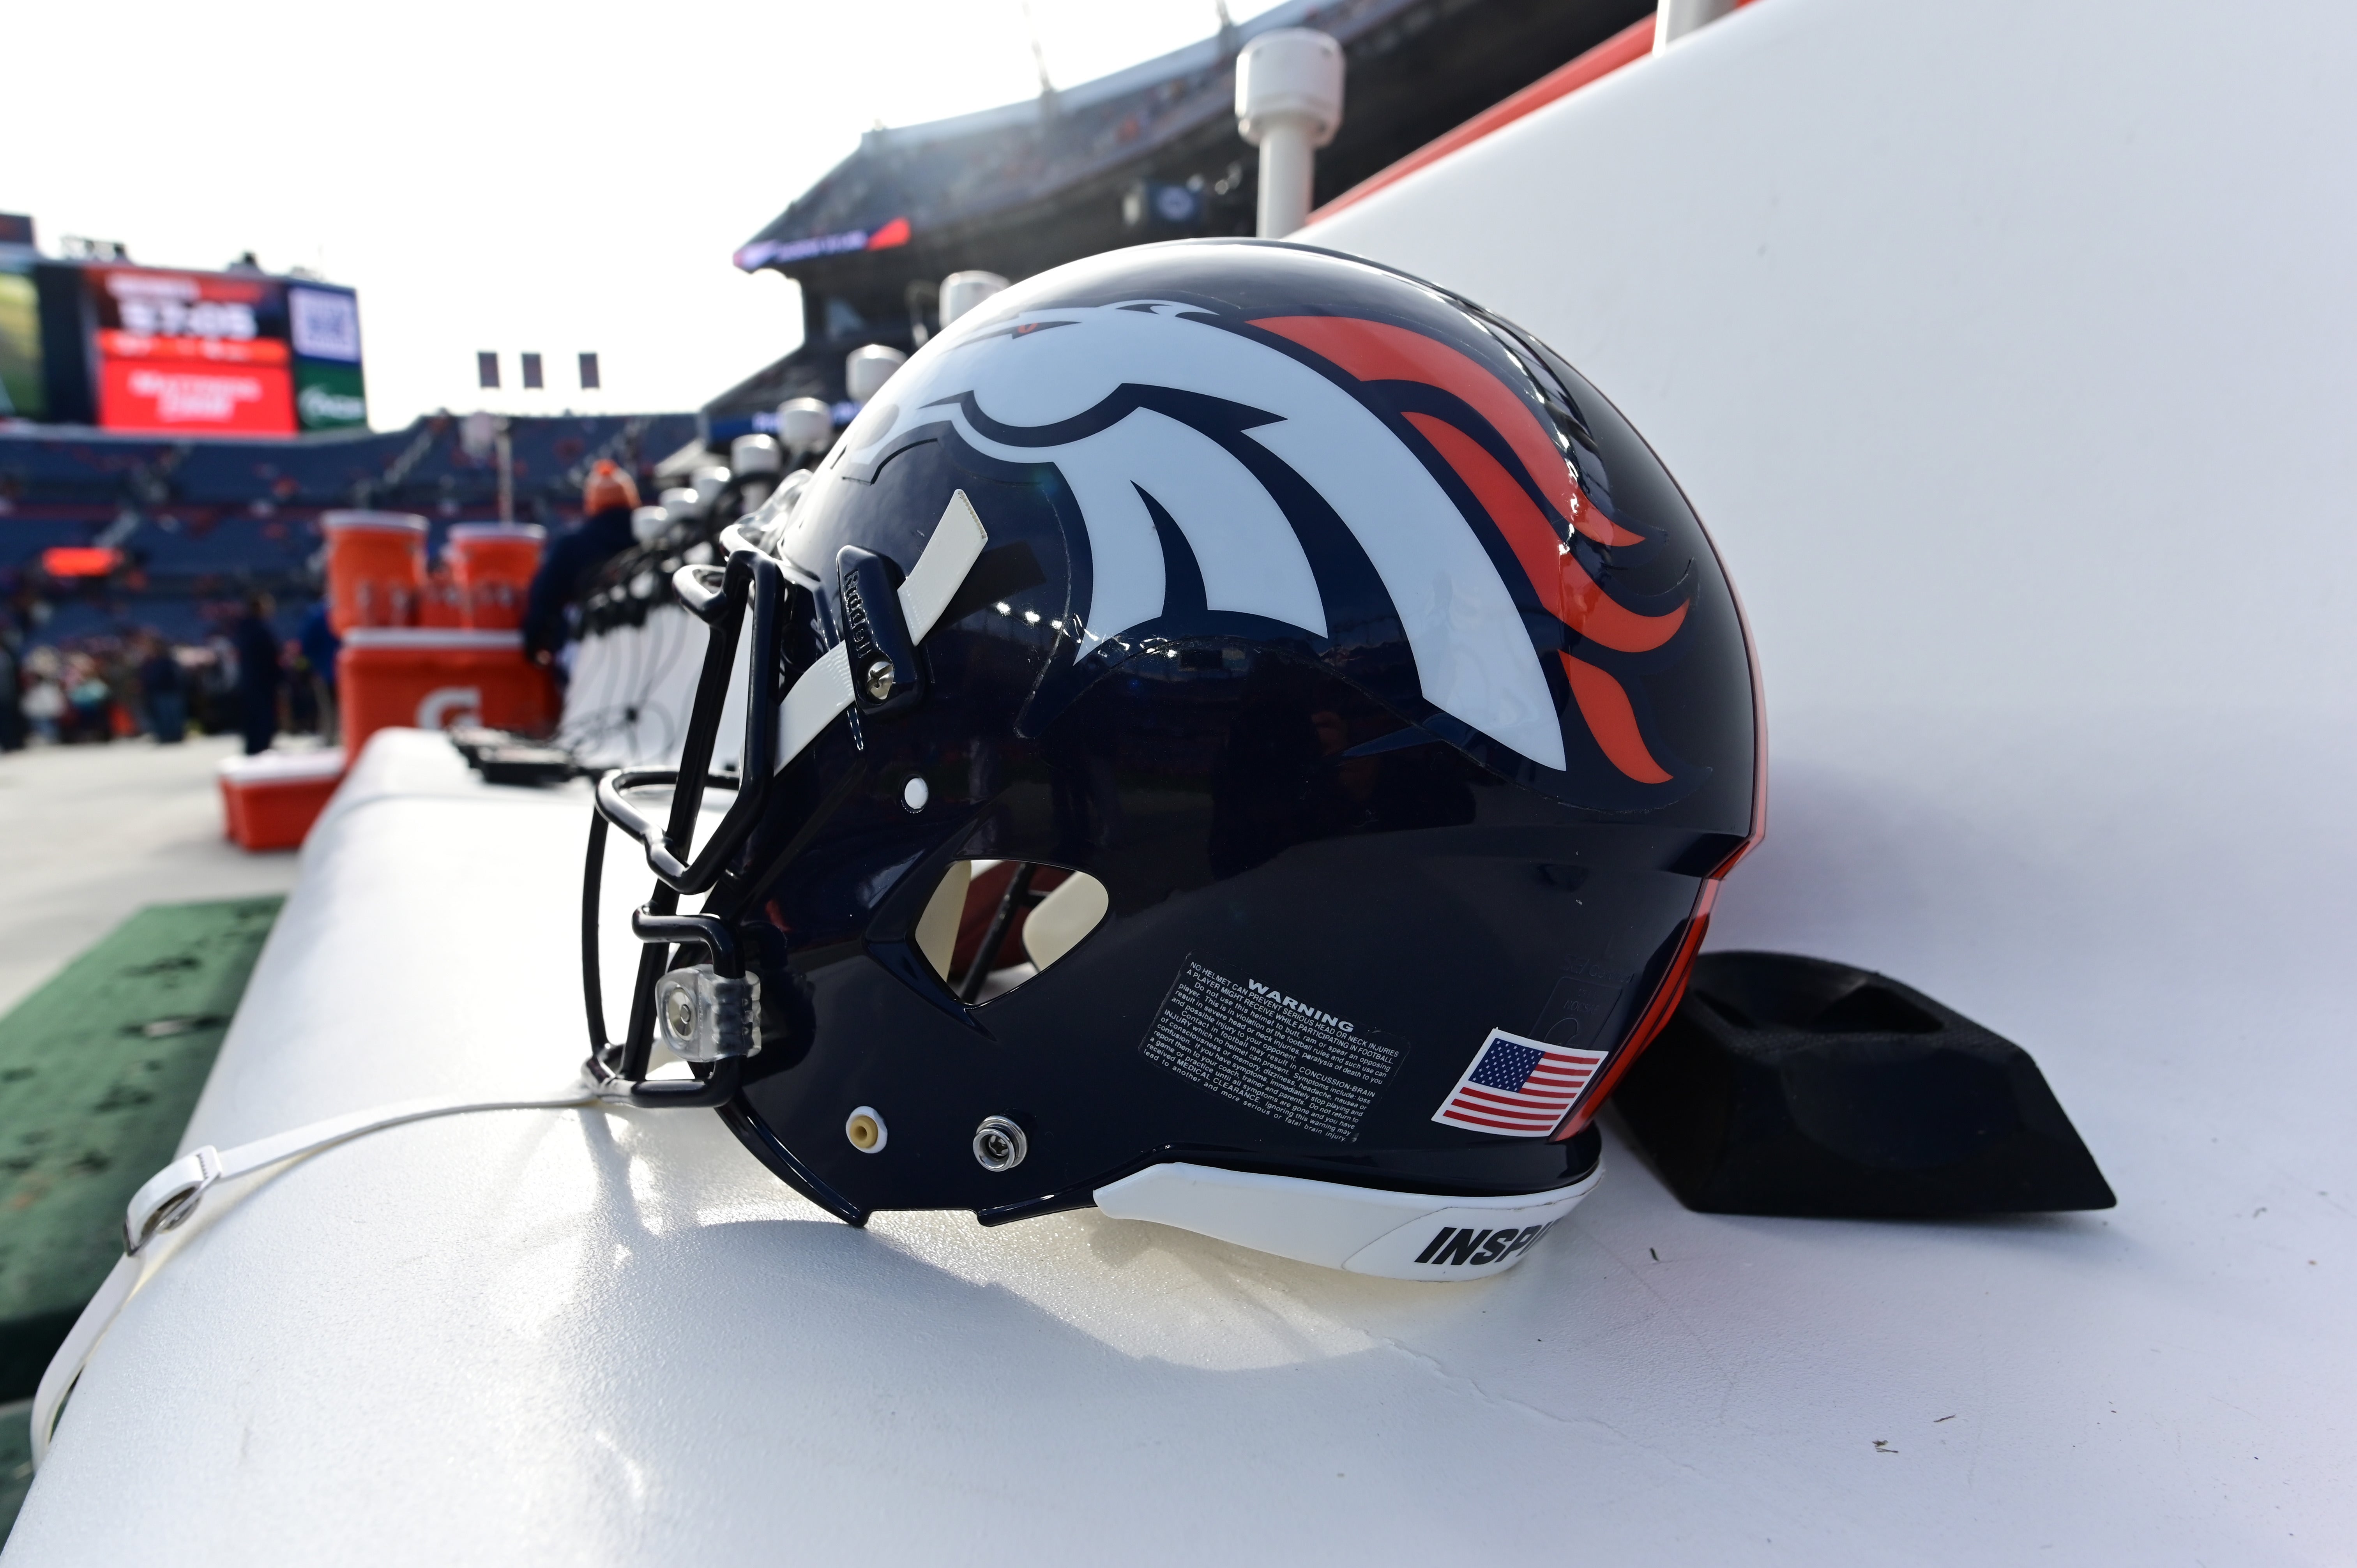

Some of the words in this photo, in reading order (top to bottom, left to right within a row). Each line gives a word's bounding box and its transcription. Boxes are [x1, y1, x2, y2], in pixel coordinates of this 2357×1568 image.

[1171, 997, 1186, 1007] and
[1184, 1005, 1215, 1023] possible
[1216, 1019, 1237, 1034] injury
[1245, 1035, 1262, 1045] your
[1263, 1044, 1296, 1062] opponent.
[1175, 990, 1195, 1004] result
[1204, 1006, 1227, 1021] severe
[1228, 1017, 1246, 1030] head
[1255, 1031, 1273, 1042] neck
[1274, 1038, 1300, 1056] injuries,
[1301, 1052, 1333, 1068] paralysis
[1343, 1067, 1361, 1077] death
[1178, 984, 1201, 998] player.
[1205, 996, 1219, 1008] This
[1236, 1013, 1265, 1030] violation
[1274, 1030, 1285, 1040] the
[1286, 1036, 1313, 1051] football
[1313, 1048, 1330, 1058] rules
[1330, 1055, 1345, 1063] and
[1344, 1060, 1361, 1069] such
[1190, 961, 1201, 971] NO
[1202, 968, 1232, 987] HELMET
[1232, 984, 1248, 995] CAN
[1248, 992, 1283, 1011] PREVENT
[1282, 1008, 1315, 1026] SERIOUS
[1315, 1022, 1335, 1035] HEAD
[1336, 1031, 1347, 1039] OR
[1348, 1035, 1368, 1047] NECK
[1368, 1043, 1399, 1057] INJURIES
[1193, 972, 1220, 990] PLAYER
[1220, 987, 1244, 1002] MIGHT
[1244, 998, 1275, 1017] RECEIVE
[1276, 1013, 1298, 1028] WHILE
[1298, 1023, 1349, 1049] PARTICIPATING
[1357, 1047, 1393, 1064] FOOTBALL.
[1194, 982, 1205, 991] Do
[1206, 989, 1219, 999] not
[1220, 996, 1233, 1006] use
[1235, 1003, 1249, 1014] this
[1250, 1010, 1275, 1026] helmet
[1285, 1026, 1300, 1039] butt,
[1303, 1036, 1317, 1045] ram
[1328, 1046, 1348, 1056] spear
[1359, 1058, 1391, 1072] opposing
[1248, 978, 1354, 1032] WARNING
[1143, 1049, 1159, 1061] lead
[1172, 1066, 1201, 1082] another
[1203, 1082, 1219, 1091] and
[1221, 1090, 1240, 1102] more
[1243, 1100, 1270, 1115] serious
[1285, 1117, 1302, 1127] fatal
[1304, 1124, 1323, 1134] brain
[1325, 1132, 1346, 1142] injury.
[1147, 1044, 1176, 1061] received
[1177, 1059, 1210, 1080] MEDICAL
[1213, 1077, 1261, 1104] CLEARANCE.
[1265, 1101, 1294, 1118] Ignoring
[1295, 1113, 1308, 1121] this
[1310, 1119, 1336, 1132] warning
[1337, 1128, 1352, 1136] may
[1154, 1030, 1174, 1044] report
[1175, 1041, 1192, 1054] them
[1200, 1056, 1218, 1066] your
[1218, 1065, 1240, 1079] coach,
[1242, 1075, 1265, 1088] trainer
[1265, 1086, 1279, 1095] and
[1278, 1092, 1305, 1105] parents.
[1331, 1111, 1351, 1121] return
[1155, 1040, 1175, 1053] game
[1184, 1056, 1214, 1073] practice
[1215, 1071, 1232, 1082] until
[1242, 1084, 1278, 1102] symptoms
[1292, 1105, 1310, 1114] gone
[1339, 1120, 1355, 1129] have
[1157, 1024, 1191, 1045] confusion.
[1200, 1047, 1214, 1056] you
[1214, 1053, 1231, 1065] have
[1232, 1063, 1268, 1083] symptoms,
[1270, 1079, 1310, 1100] immediately
[1311, 1097, 1326, 1105] stop
[1325, 1102, 1350, 1114] playing
[1164, 1009, 1193, 1027] INJURY
[1193, 1026, 1213, 1039] which
[1224, 1041, 1248, 1056] helmet
[1249, 1054, 1262, 1063] can
[1262, 1060, 1289, 1075] prevent.
[1293, 1072, 1329, 1090] Symptoms
[1330, 1086, 1356, 1100] include:
[1357, 1095, 1371, 1104] loss
[1169, 1022, 1221, 1052] consciousness
[1232, 1054, 1261, 1072] memory,
[1263, 1069, 1296, 1087] dizziness,
[1298, 1082, 1332, 1100] headache,
[1334, 1097, 1359, 1108] nausea
[1181, 1010, 1209, 1029] Contact
[1220, 1030, 1249, 1048] football
[1249, 1046, 1265, 1057] may
[1267, 1054, 1288, 1066] result
[1299, 1067, 1376, 1098] CONCUSSION-BRAIN
[1414, 1217, 1562, 1266] INSPI
